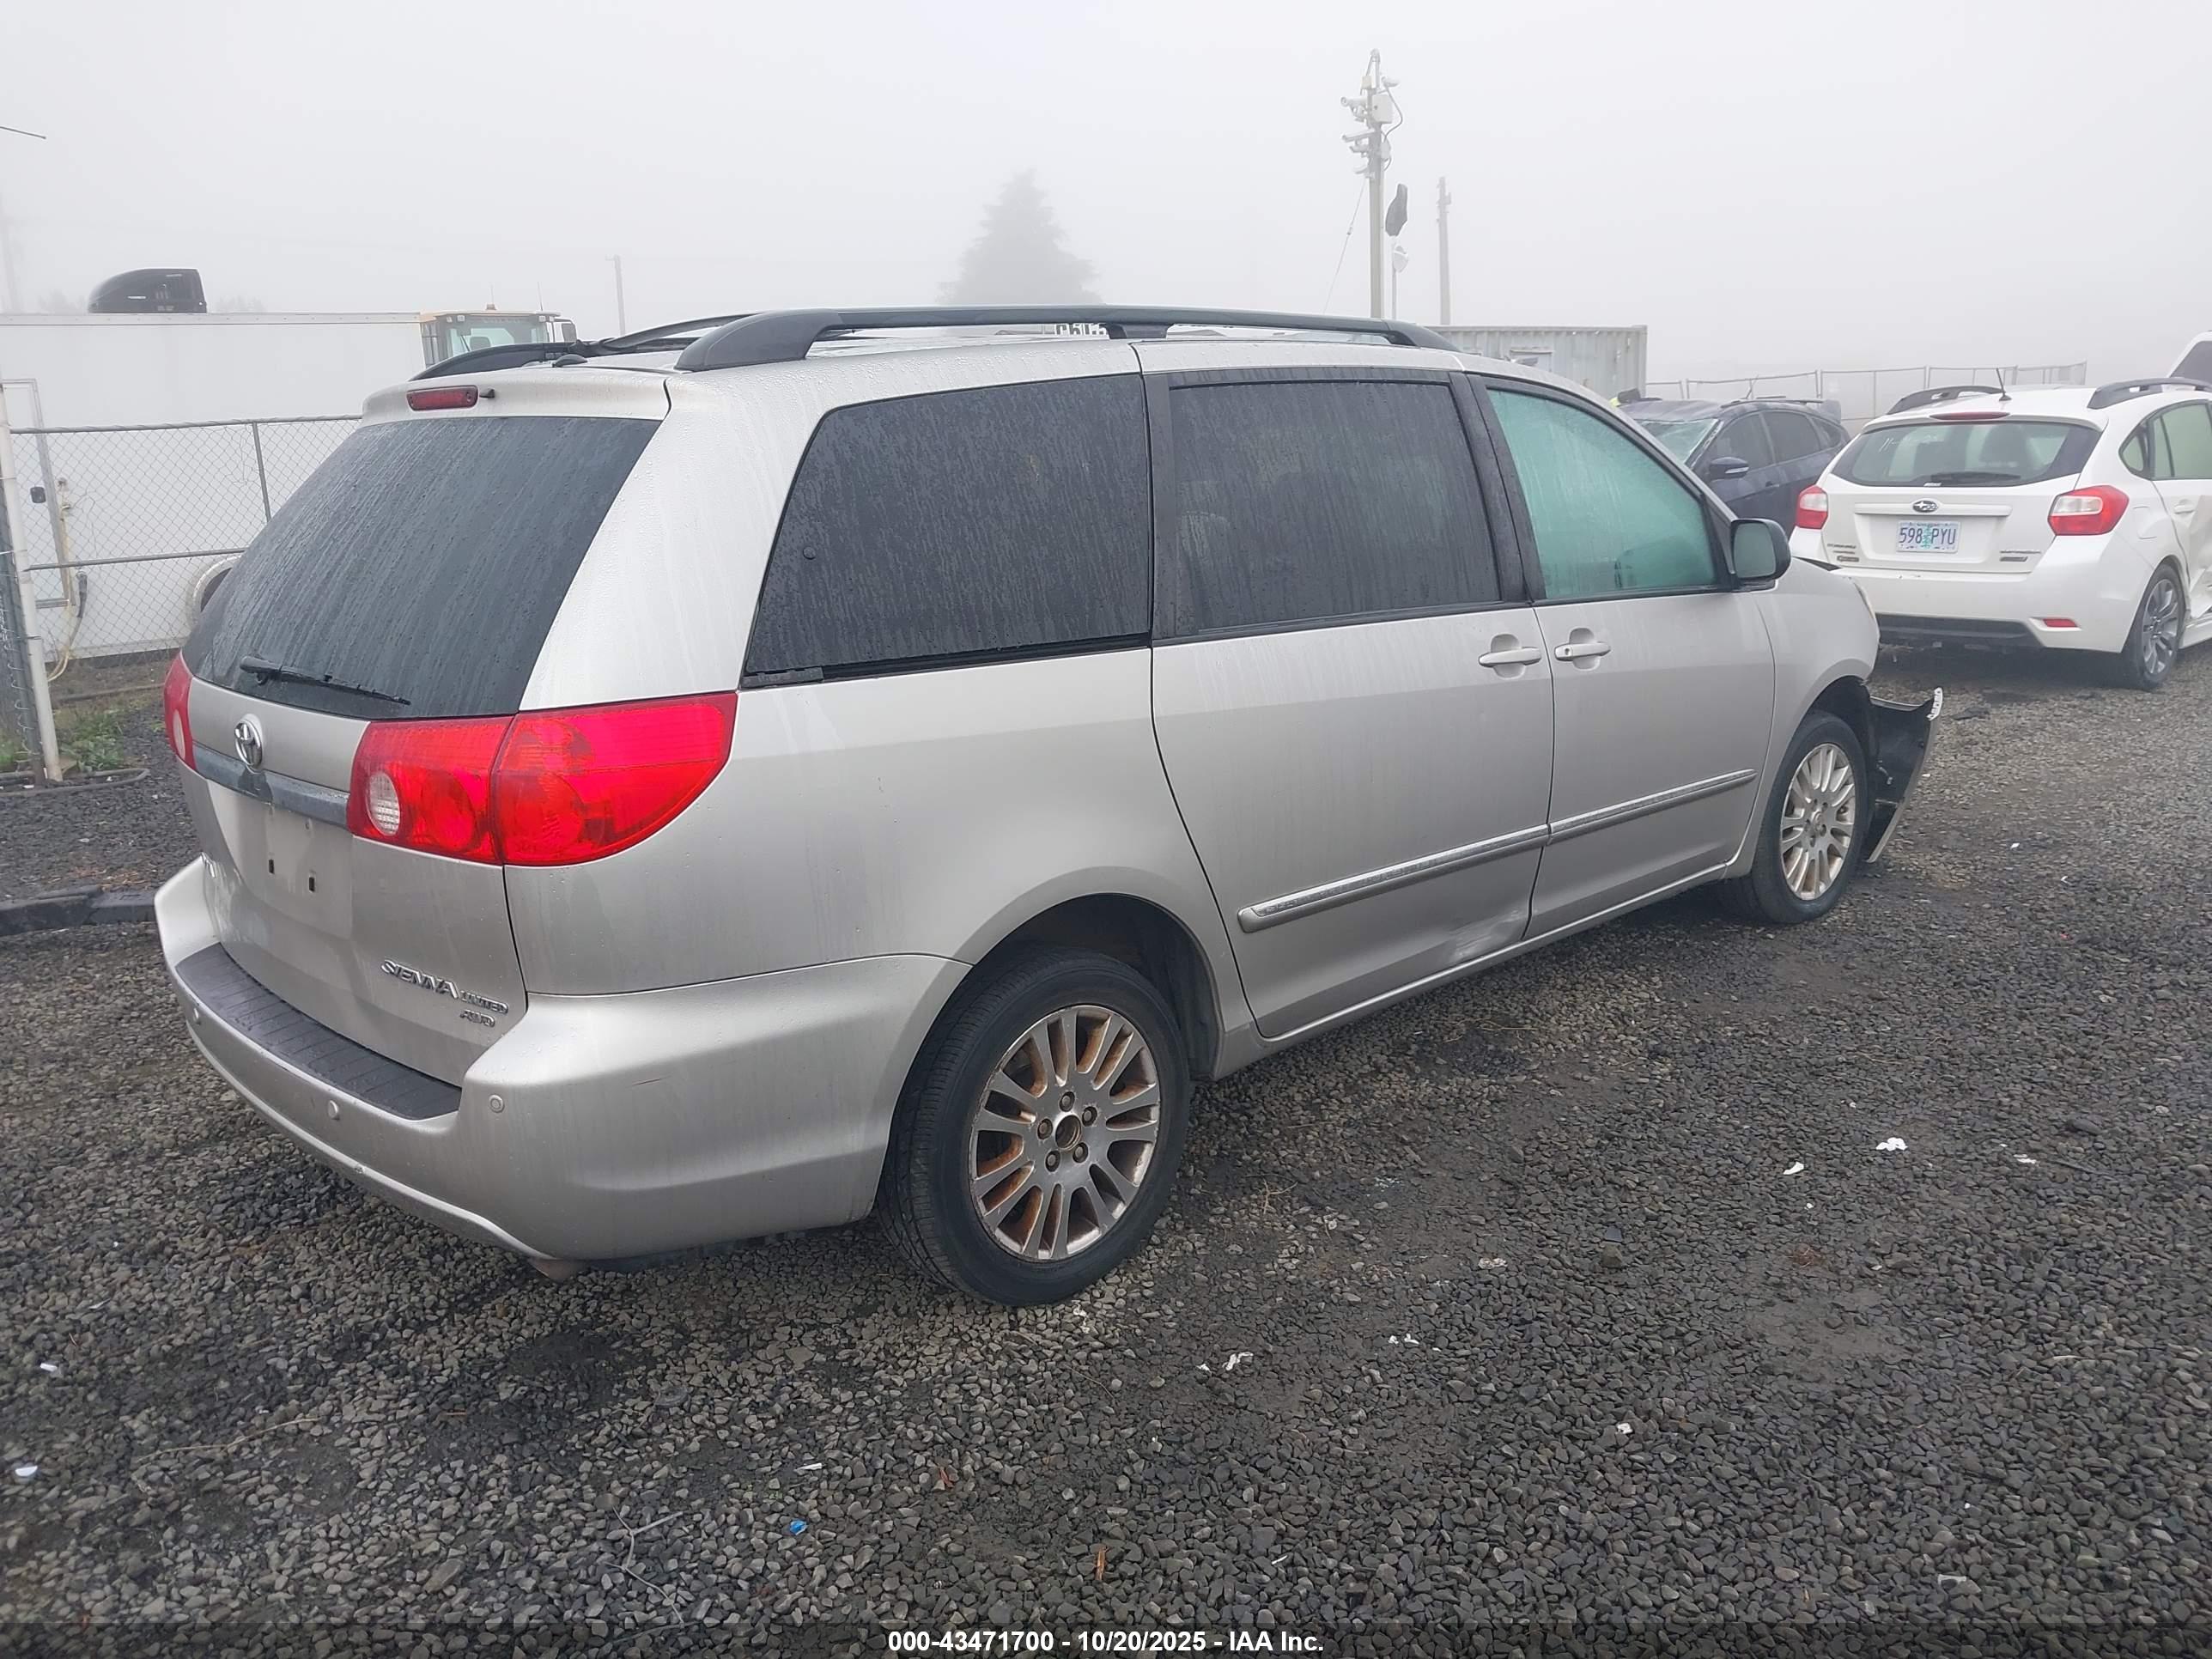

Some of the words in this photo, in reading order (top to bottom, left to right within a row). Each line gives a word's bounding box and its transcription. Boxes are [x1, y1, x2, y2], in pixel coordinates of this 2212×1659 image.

[1899, 527, 1923, 544] 598
[1930, 528, 1957, 545] PYU
[380, 959, 459, 1000] SIENNA
